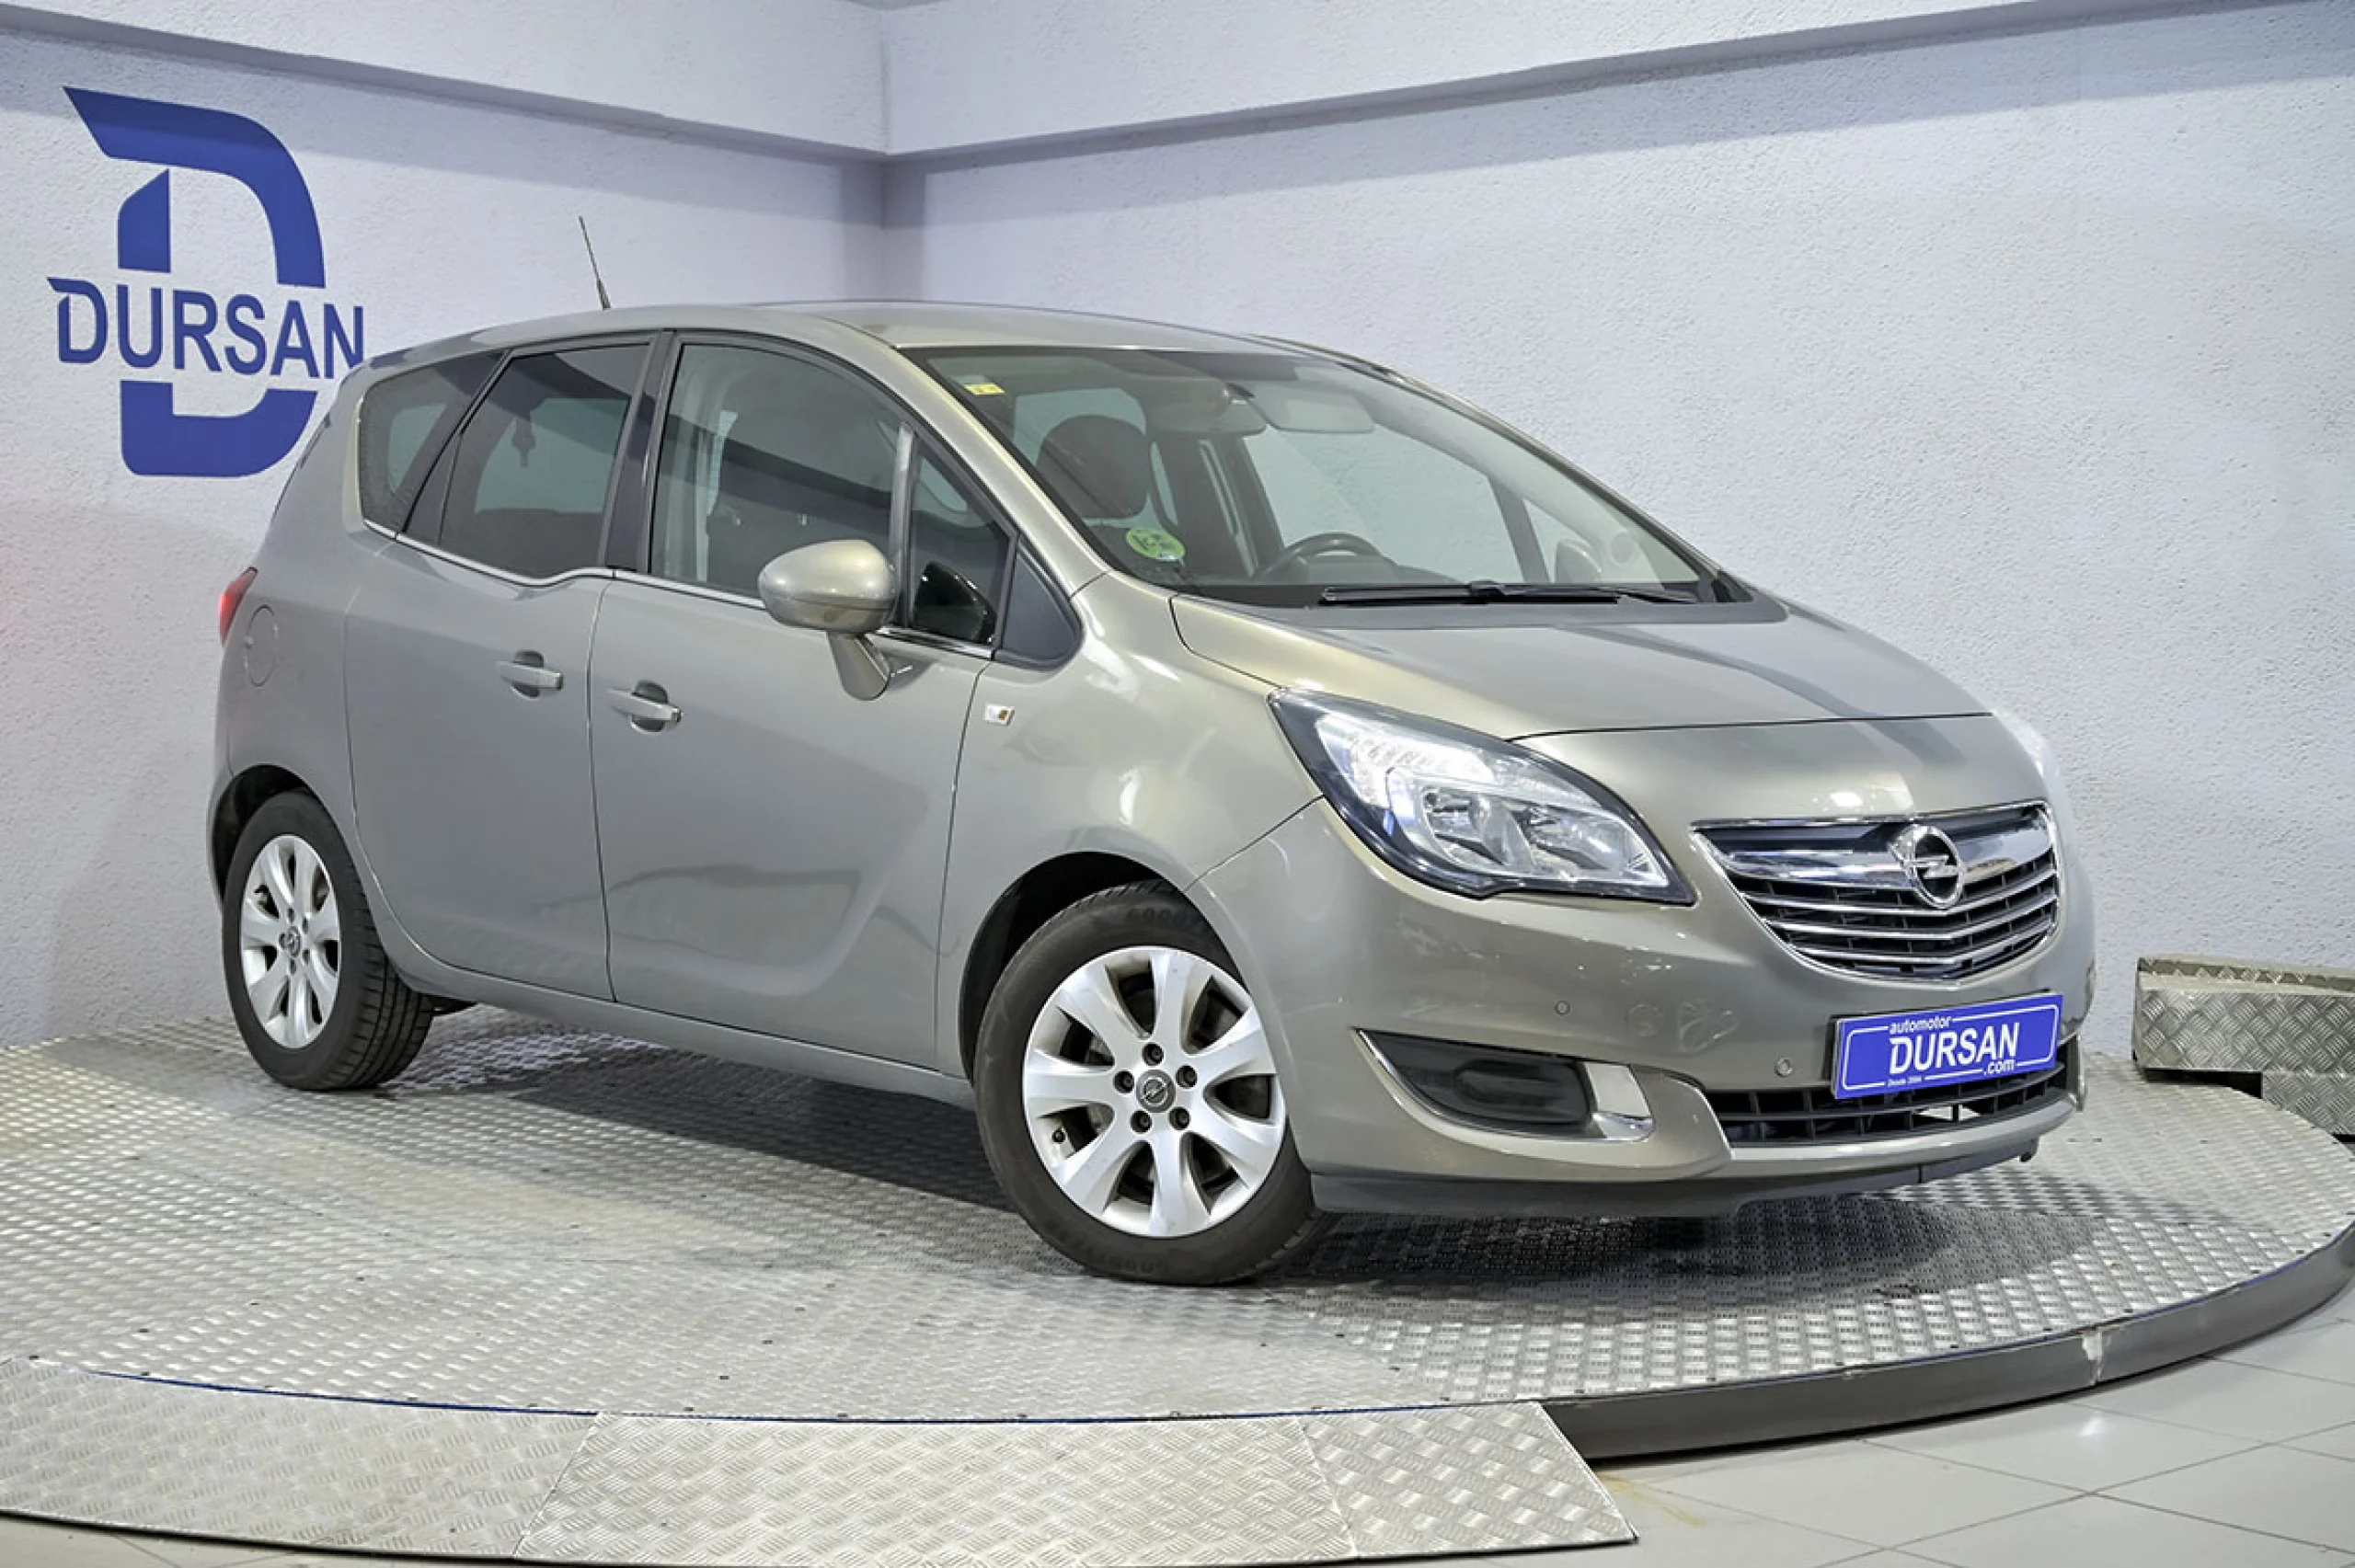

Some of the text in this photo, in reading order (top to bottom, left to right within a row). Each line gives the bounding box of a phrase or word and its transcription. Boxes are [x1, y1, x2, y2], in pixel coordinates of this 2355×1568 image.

[46, 276, 364, 379] DURSAN
[1889, 1015, 1951, 1035] automotor
[1889, 1022, 2019, 1074] DURSAN
[1983, 1059, 2015, 1076] .com
